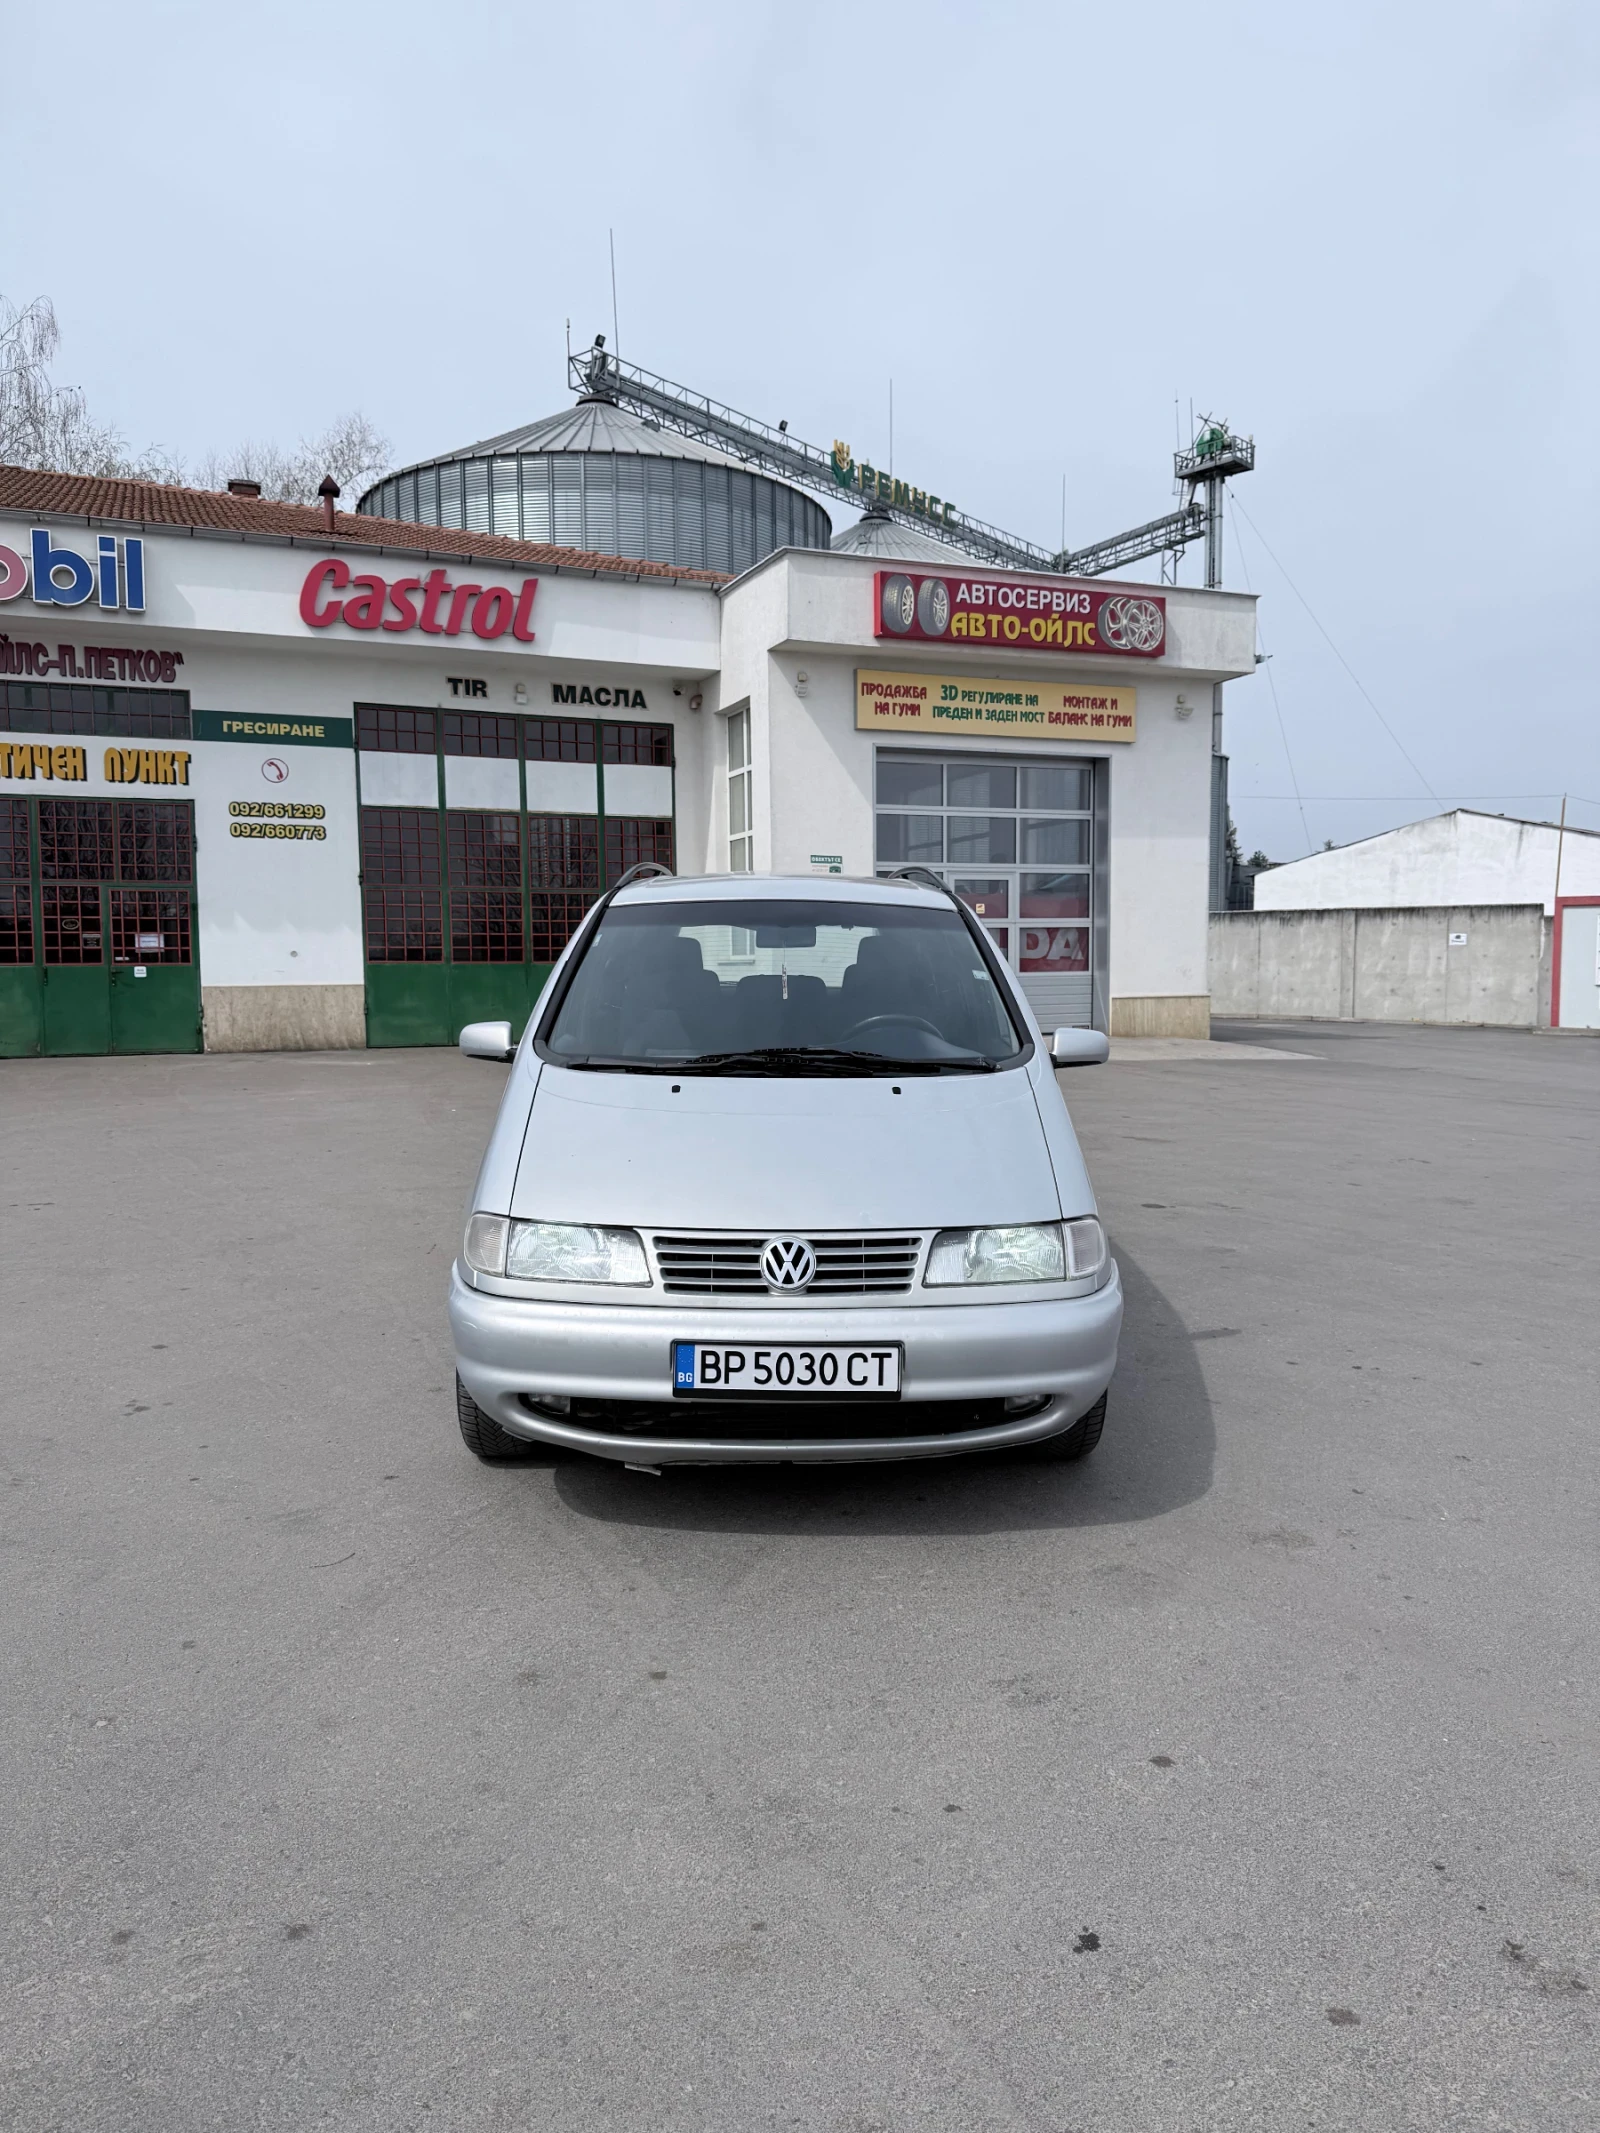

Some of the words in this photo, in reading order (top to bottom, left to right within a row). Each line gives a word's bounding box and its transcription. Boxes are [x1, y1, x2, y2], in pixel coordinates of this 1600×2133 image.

[299, 558, 539, 641] Castrol
[956, 583, 1091, 614] АВТОСЕРВИЗ
[951, 612, 1096, 648] АВТО-ОЙЛС
[447, 677, 488, 698] TIR
[552, 684, 647, 709] МАСЛА
[861, 682, 927, 700] ПРОДАЖБА
[941, 684, 958, 701] 3D
[961, 690, 1023, 705] РЕГУЛИРАНЕ
[1025, 693, 1038, 706] НА
[875, 701, 889, 716] НА
[892, 702, 921, 717] ГУМИ
[1063, 695, 1107, 710] МОНТАЖ
[1111, 698, 1118, 710] И
[932, 706, 972, 721] ПРЕДЕН
[975, 707, 982, 720] И
[985, 709, 1017, 723] ЗАДЕН
[1020, 711, 1045, 723] МОСТ
[1048, 711, 1088, 726] БАЛАНС
[1091, 713, 1104, 727] НА
[1107, 715, 1132, 728] ГУМИ
[222, 720, 325, 738] ГРЕСИРАНЕ
[0, 742, 87, 781] ТИЧЕН
[104, 747, 191, 785] ПУНКТ
[229, 801, 325, 819] 092/661299
[230, 823, 326, 840] 092/660773
[677, 1372, 693, 1383] BG
[700, 1350, 745, 1384] BP
[754, 1352, 838, 1385] 5030
[847, 1352, 892, 1386] CT
